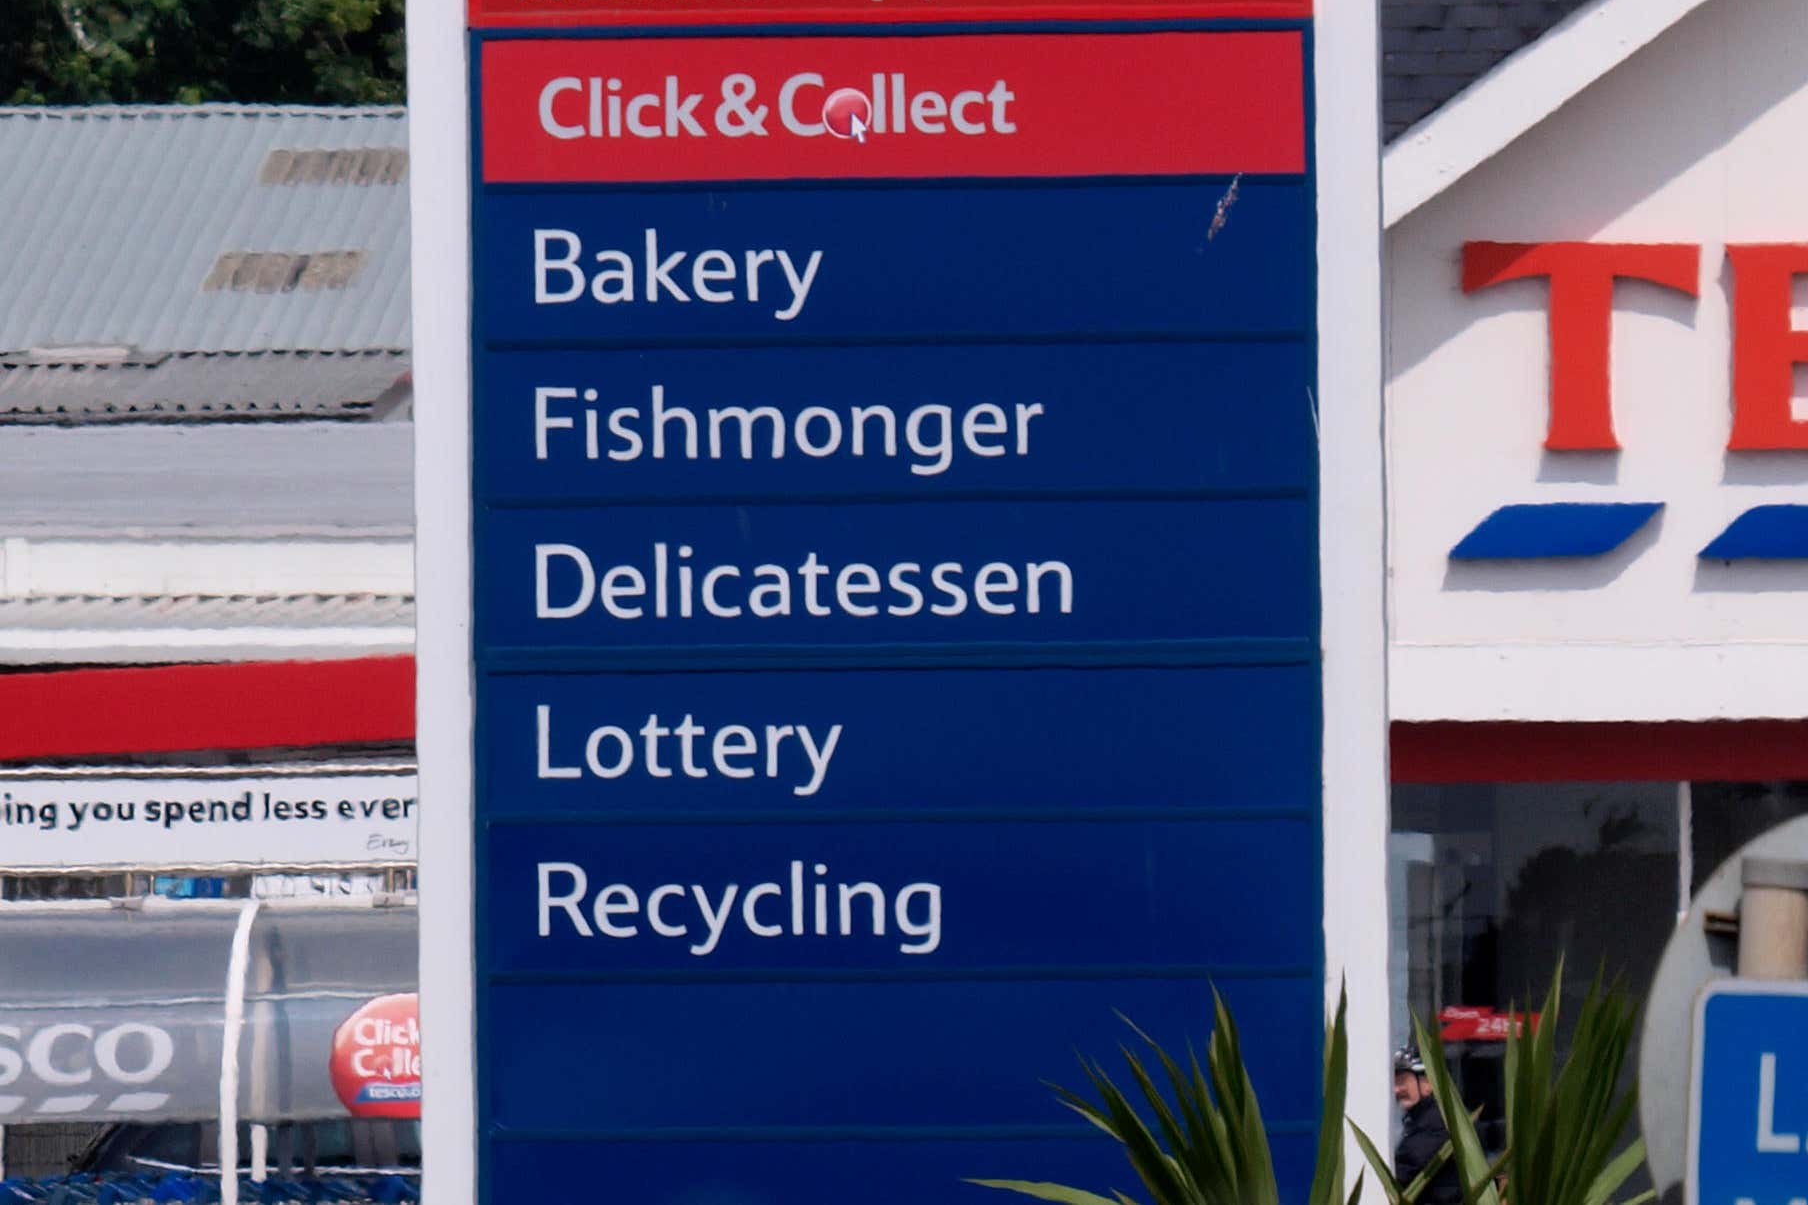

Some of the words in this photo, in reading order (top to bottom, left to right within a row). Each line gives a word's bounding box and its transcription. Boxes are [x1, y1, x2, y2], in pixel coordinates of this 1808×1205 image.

[534, 228, 822, 320] Bakery
[535, 385, 1043, 475] Fishmonger
[535, 543, 1073, 620] Delicatessen
[537, 704, 842, 796] Lottery
[67, 801, 135, 832] you
[145, 791, 252, 829] spend
[263, 792, 327, 821] less
[538, 860, 941, 955] Recycling
